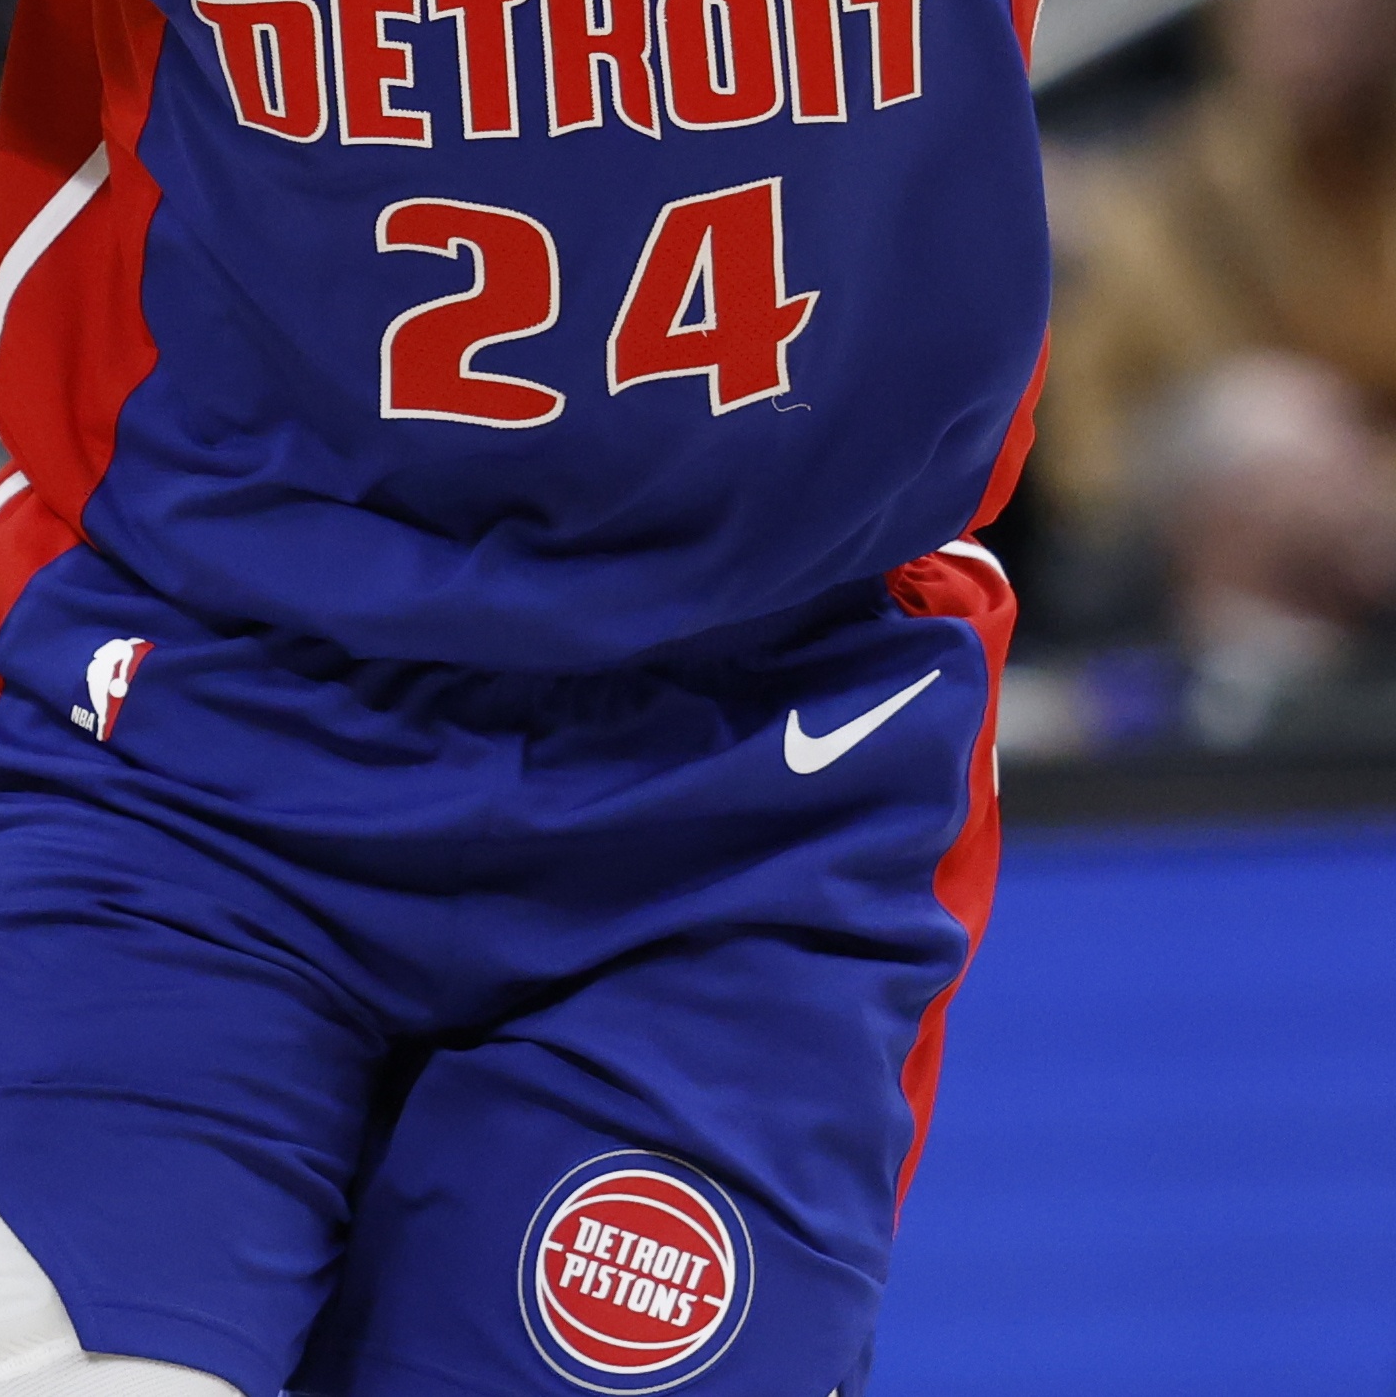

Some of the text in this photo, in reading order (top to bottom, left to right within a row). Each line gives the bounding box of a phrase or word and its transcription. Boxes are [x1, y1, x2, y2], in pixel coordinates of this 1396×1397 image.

[375, 176, 820, 430] 24
[70, 704, 96, 732] NBA
[559, 1251, 698, 1328] PISTONS
[572, 1216, 711, 1291] DETROIT
